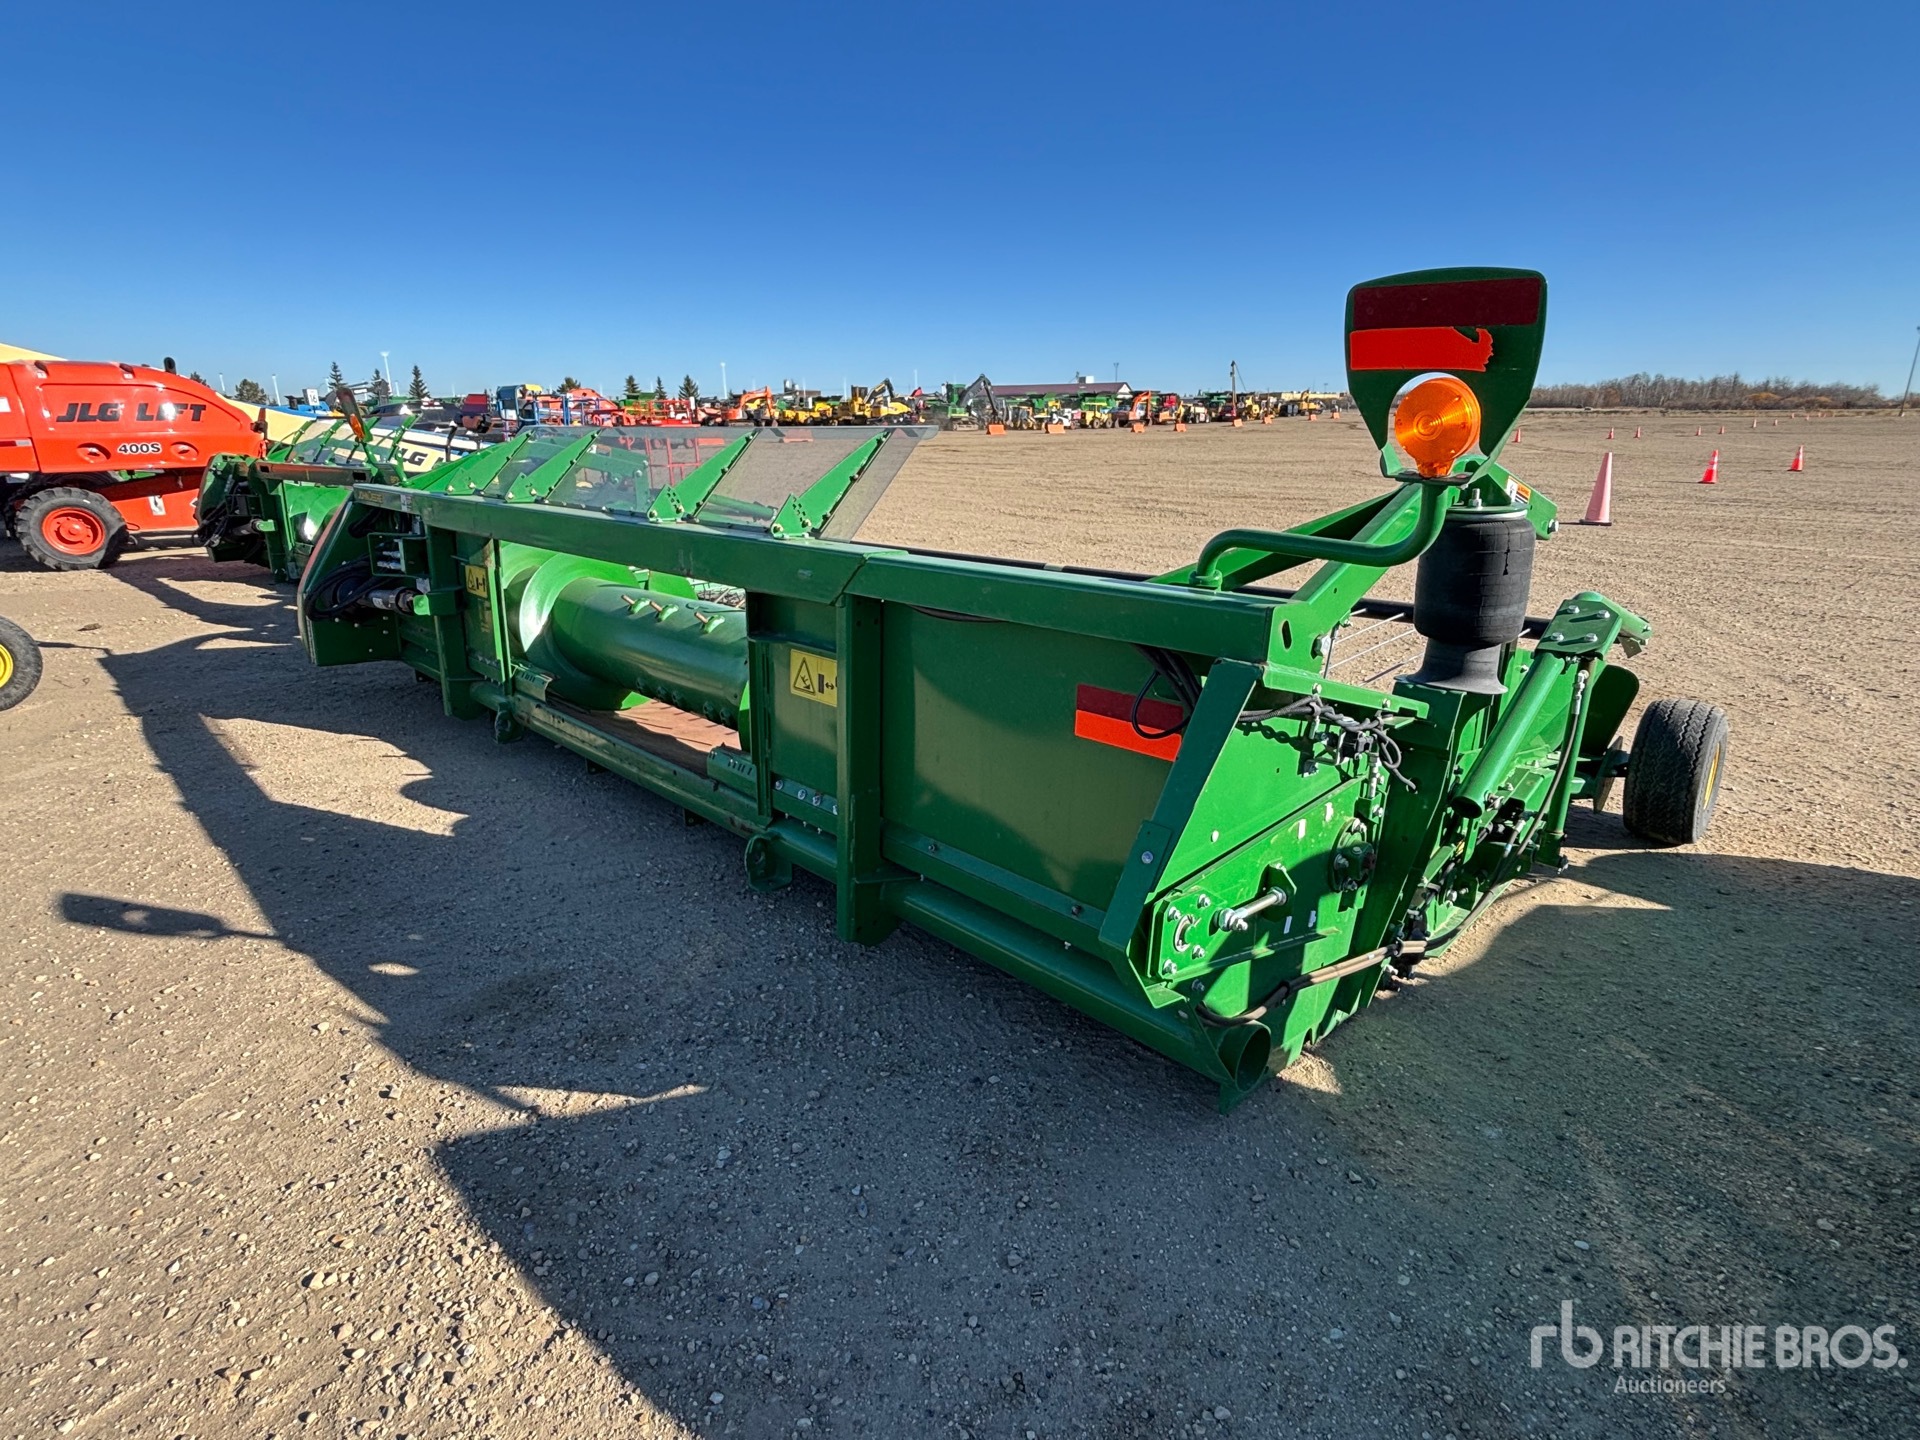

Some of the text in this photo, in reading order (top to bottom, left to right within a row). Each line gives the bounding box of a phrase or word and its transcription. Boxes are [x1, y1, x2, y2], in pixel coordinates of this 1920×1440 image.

[56, 402, 122, 422] JLG
[117, 443, 162, 454] 400S
[399, 447, 428, 466] LG
